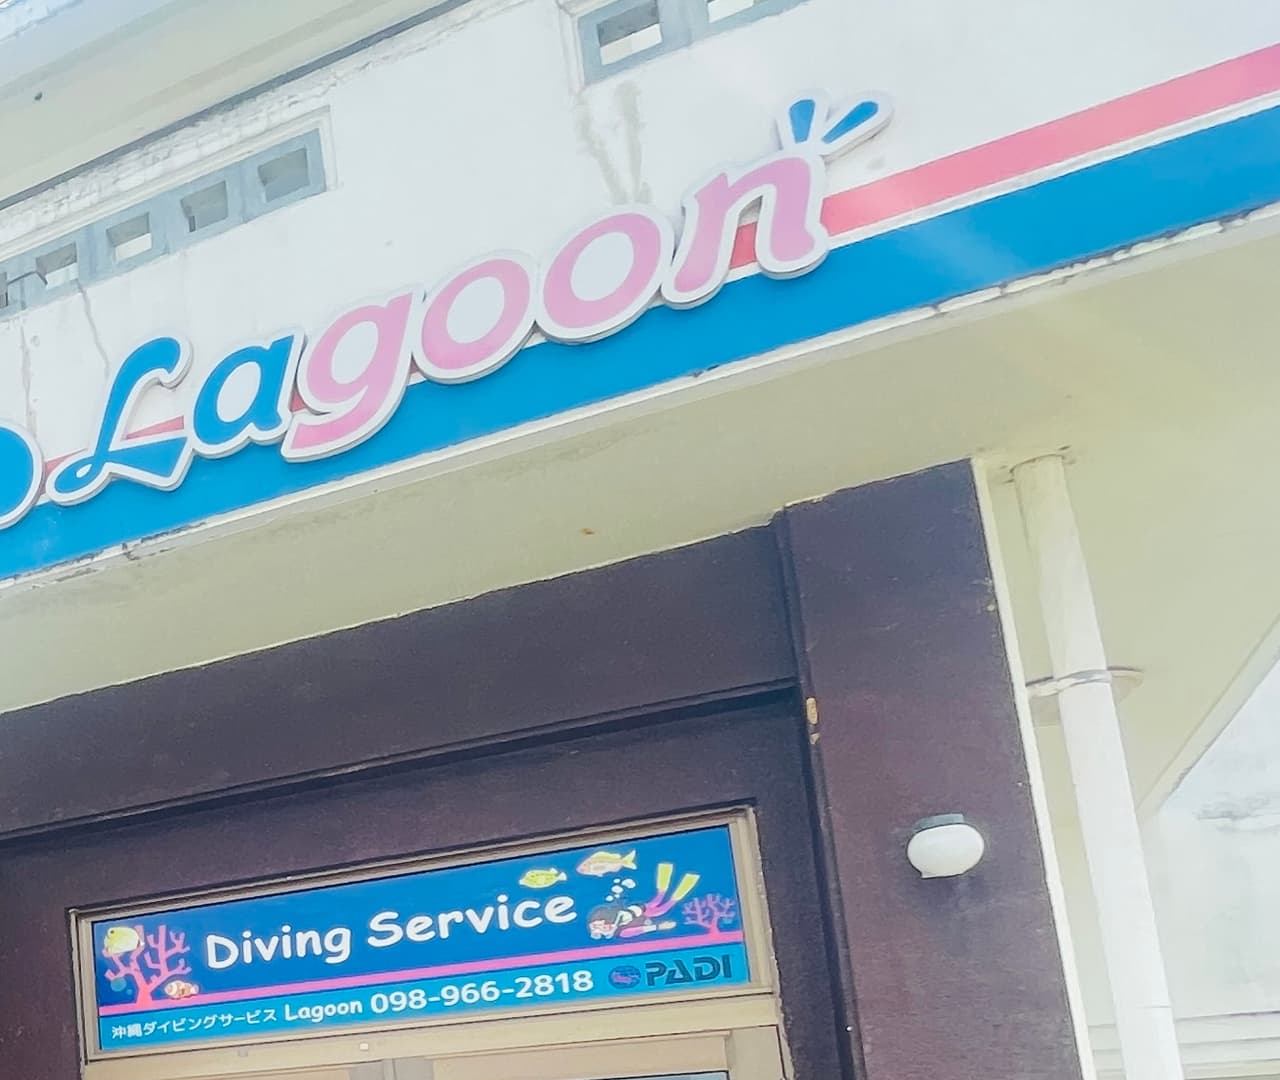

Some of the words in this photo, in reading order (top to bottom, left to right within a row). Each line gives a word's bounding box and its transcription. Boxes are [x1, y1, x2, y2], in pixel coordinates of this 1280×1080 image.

[52, 154, 822, 493] Lagoon
[206, 924, 352, 969] Diving
[367, 894, 577, 949] Service
[112, 1008, 277, 1039] 沖縄ダイビングサービス
[284, 1000, 363, 1024] Lagoon
[370, 969, 595, 1015] 098-966-2818
[645, 954, 733, 987] PADI
